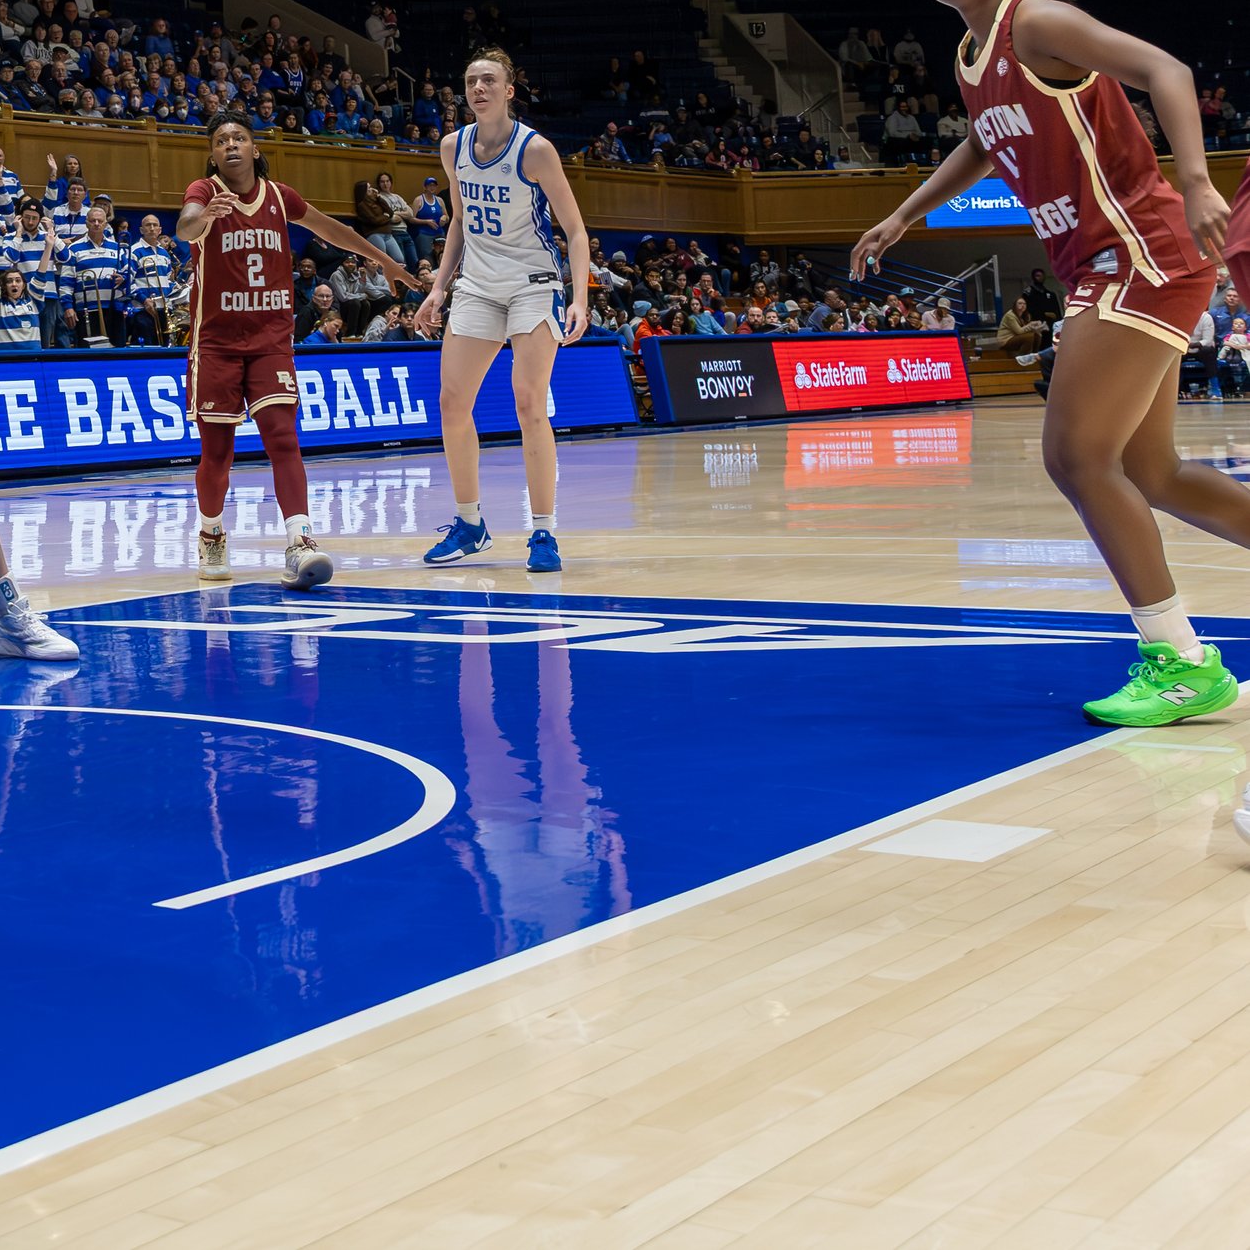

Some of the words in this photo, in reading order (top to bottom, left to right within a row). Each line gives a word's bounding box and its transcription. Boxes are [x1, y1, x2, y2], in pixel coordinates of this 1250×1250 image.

[460, 180, 510, 204] DUKE
[971, 196, 1011, 210] Harris
[467, 205, 503, 237] 35
[221, 228, 282, 253] BOSTON
[246, 253, 266, 287] 2
[221, 289, 291, 312] COLLEGE
[700, 359, 742, 373] MARRIOTT
[696, 375, 754, 399] BONVOY
[58, 365, 429, 449] BASBALL
